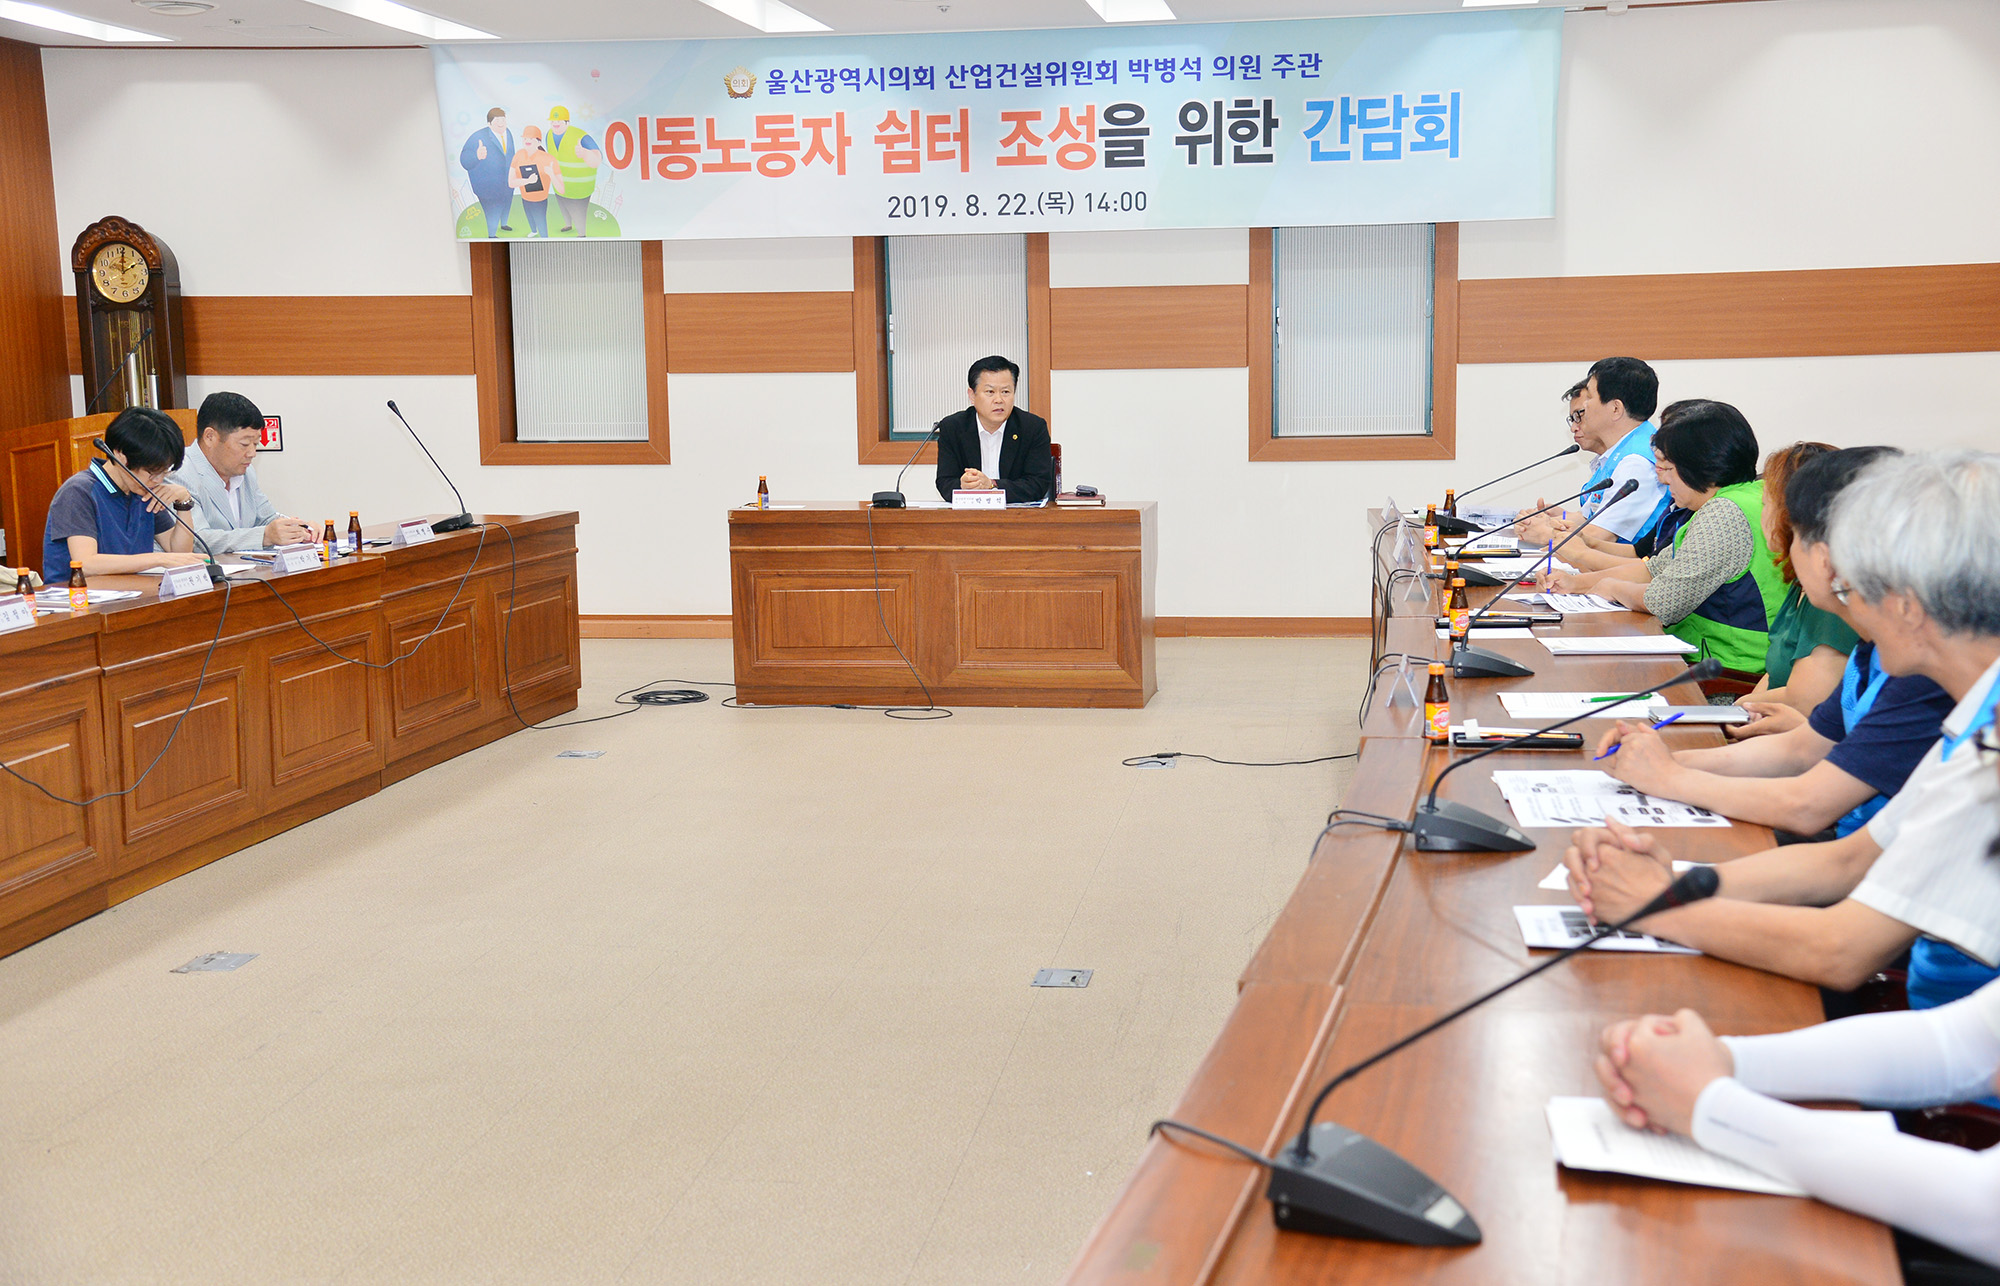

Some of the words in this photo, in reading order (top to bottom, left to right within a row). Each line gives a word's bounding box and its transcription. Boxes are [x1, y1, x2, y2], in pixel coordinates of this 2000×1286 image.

[765, 65, 935, 95] 울산광역시의회
[944, 59, 1118, 90] 산업건설위원회
[1128, 56, 1202, 84] 박병석
[1212, 54, 1262, 81] 의원
[1271, 52, 1323, 79] 주관
[604, 111, 852, 181] 이동노동자
[874, 108, 970, 174] 쉼터
[996, 103, 1150, 171] 조성을
[1175, 99, 1279, 165] 위한
[1303, 91, 1461, 162] 간담회
[888, 195, 956, 218] 2019.
[966, 194, 987, 217] 8.
[997, 191, 1074, 216] 22.(목)
[1084, 191, 1147, 213] 14:00
